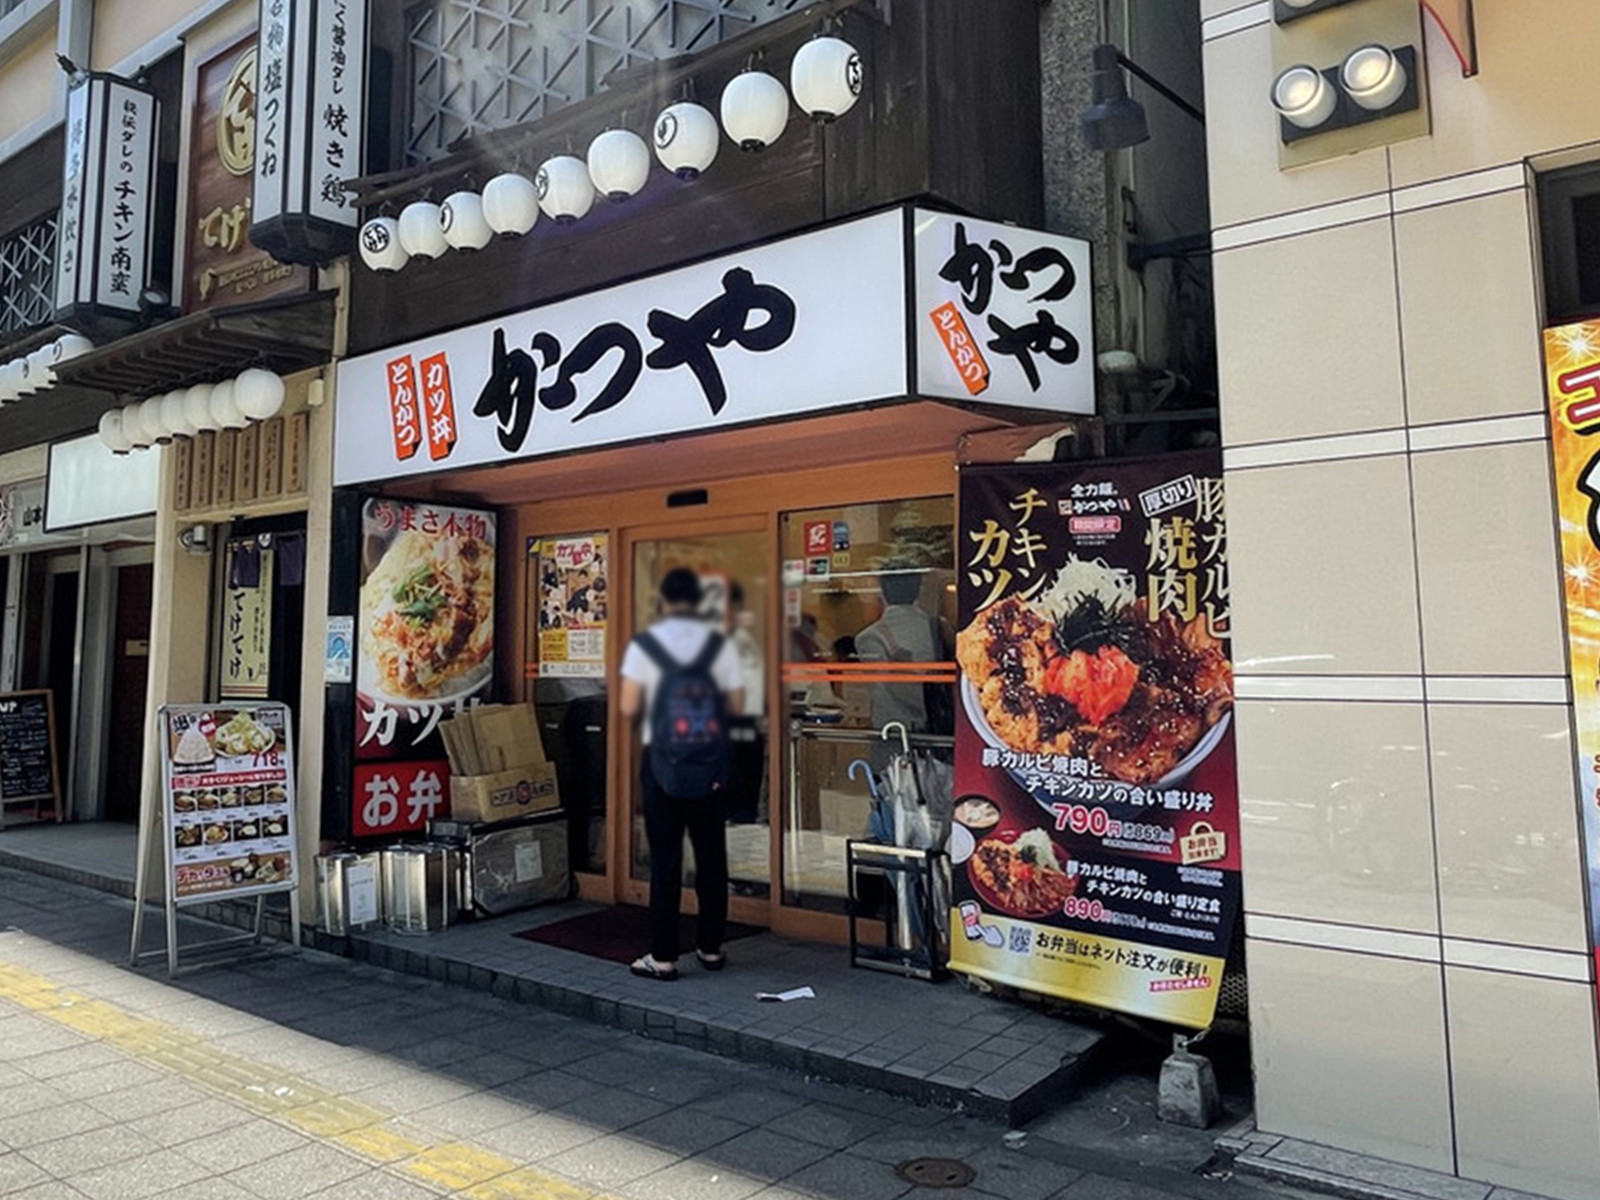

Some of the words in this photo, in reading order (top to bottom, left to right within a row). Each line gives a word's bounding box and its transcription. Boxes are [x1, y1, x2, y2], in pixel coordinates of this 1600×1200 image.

[109, 180, 137, 295] チキン南蛮
[199, 197, 251, 252] てけ
[473, 267, 796, 453] かつや
[936, 310, 982, 382] とんかつ
[391, 362, 415, 446] とんかつ
[428, 363, 451, 445] カツ丼
[1009, 487, 1048, 602] チキン
[1073, 498, 1117, 514] かつや
[967, 520, 1013, 613] カツ
[1144, 516, 1198, 623] 焼肉
[359, 698, 481, 748] カツ
[1025, 775, 1214, 812] チキンカツの合い盛り丼
[1087, 880, 1221, 914] チキンカツの合い盛り定食
[1036, 932, 1208, 979] お弁当はネット注文が便利!
